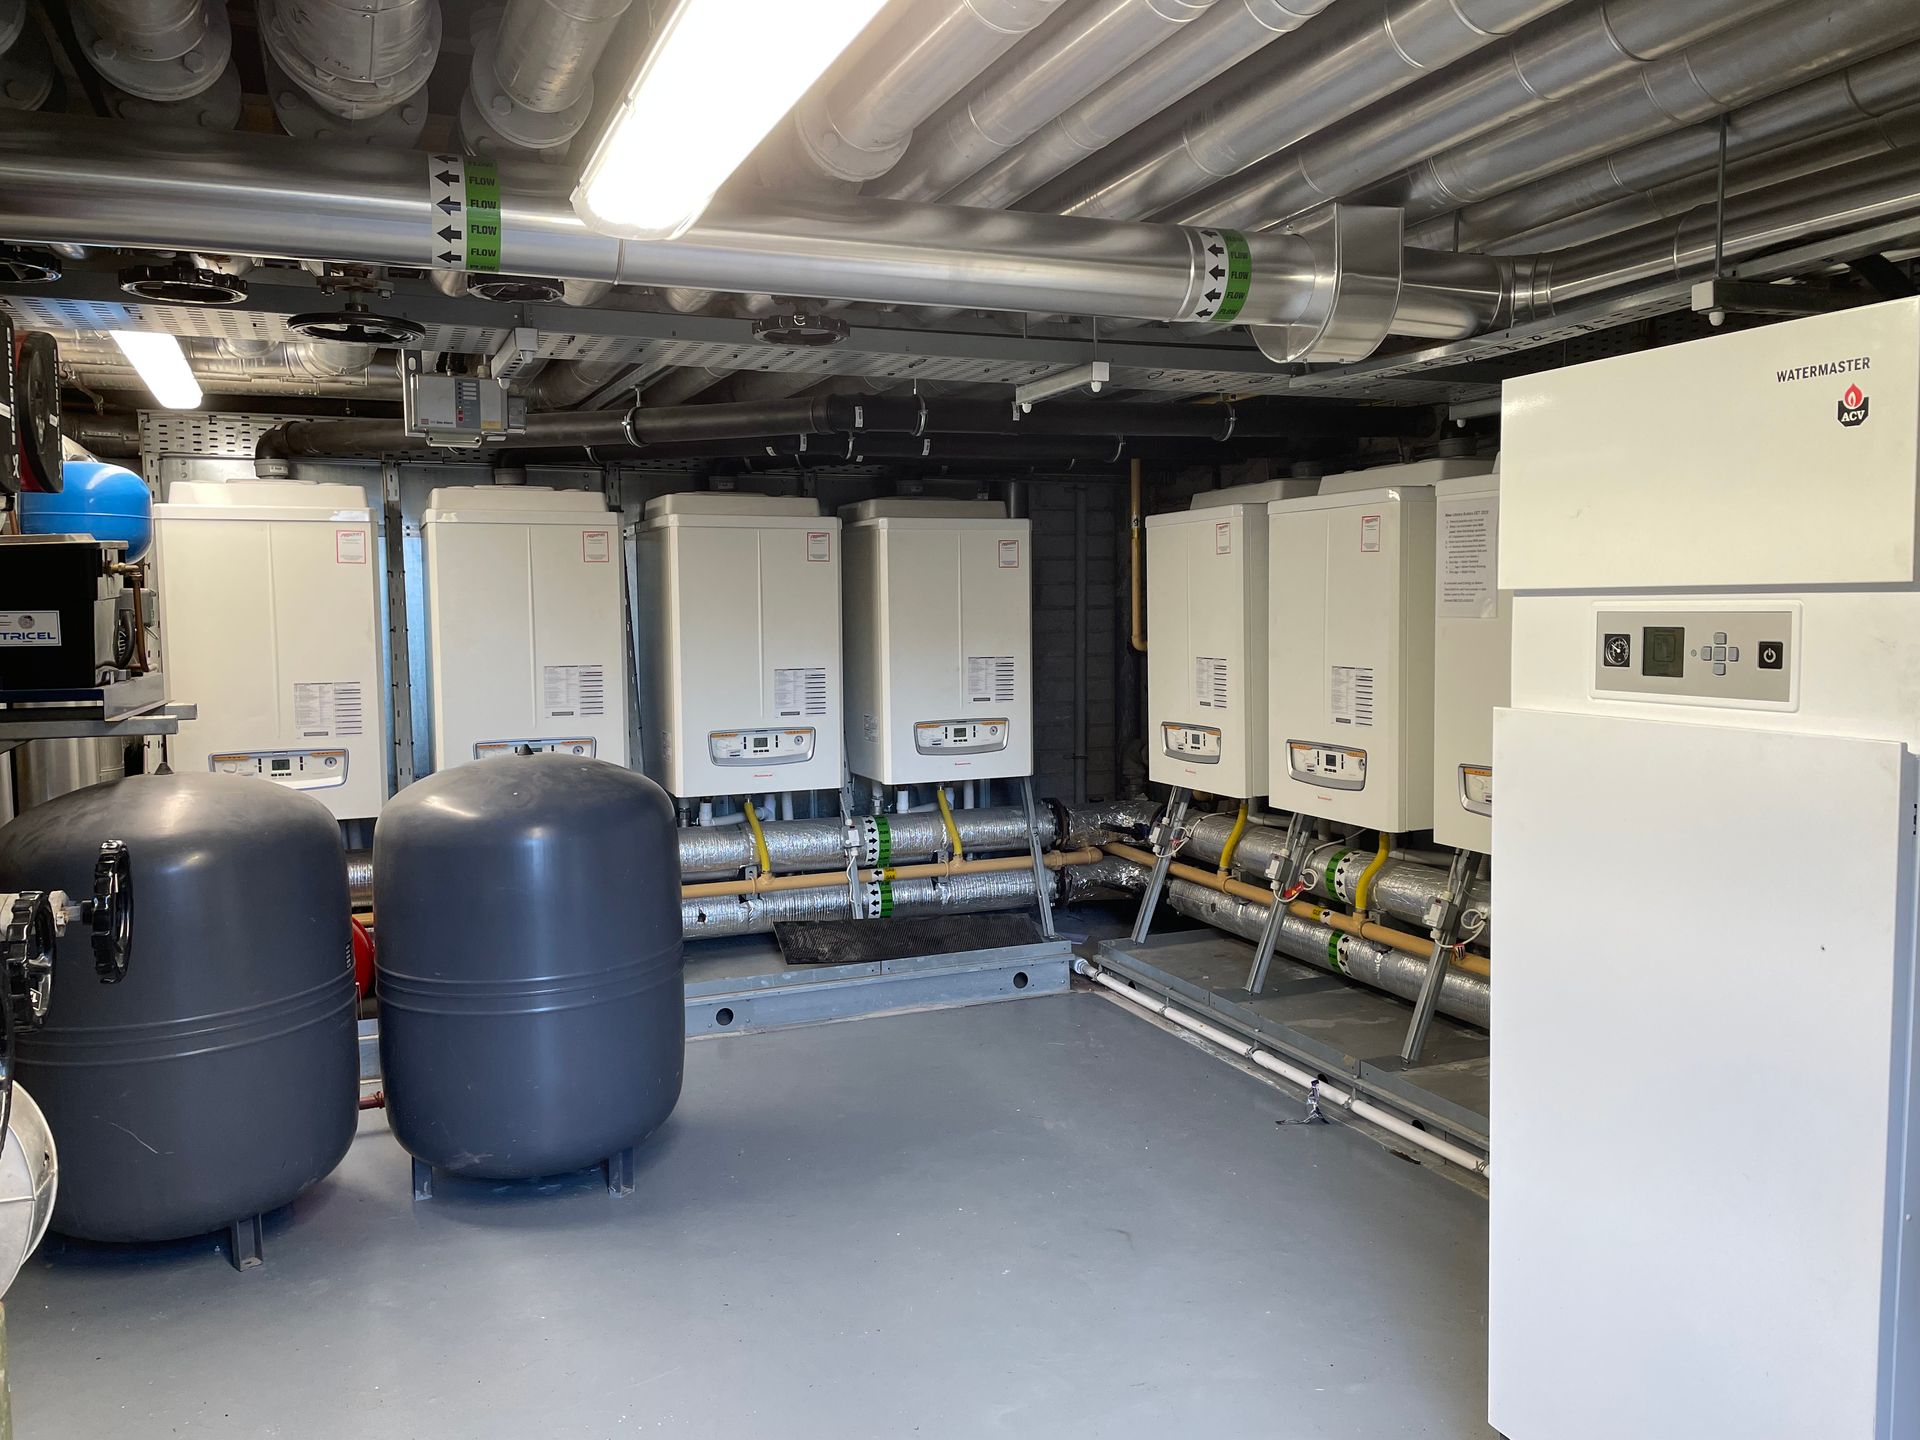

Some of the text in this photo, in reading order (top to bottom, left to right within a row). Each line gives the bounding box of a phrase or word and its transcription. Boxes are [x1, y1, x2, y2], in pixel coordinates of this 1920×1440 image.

[469, 176, 495, 187] FLOW
[470, 199, 496, 209] FLOW
[471, 224, 496, 235] FLOW
[471, 248, 496, 257] FLOW
[1231, 271, 1249, 280] FLOW
[1776, 356, 1871, 383] WATERMASTER
[1841, 409, 1866, 422] ACV
[0, 632, 56, 640] TRICEL
